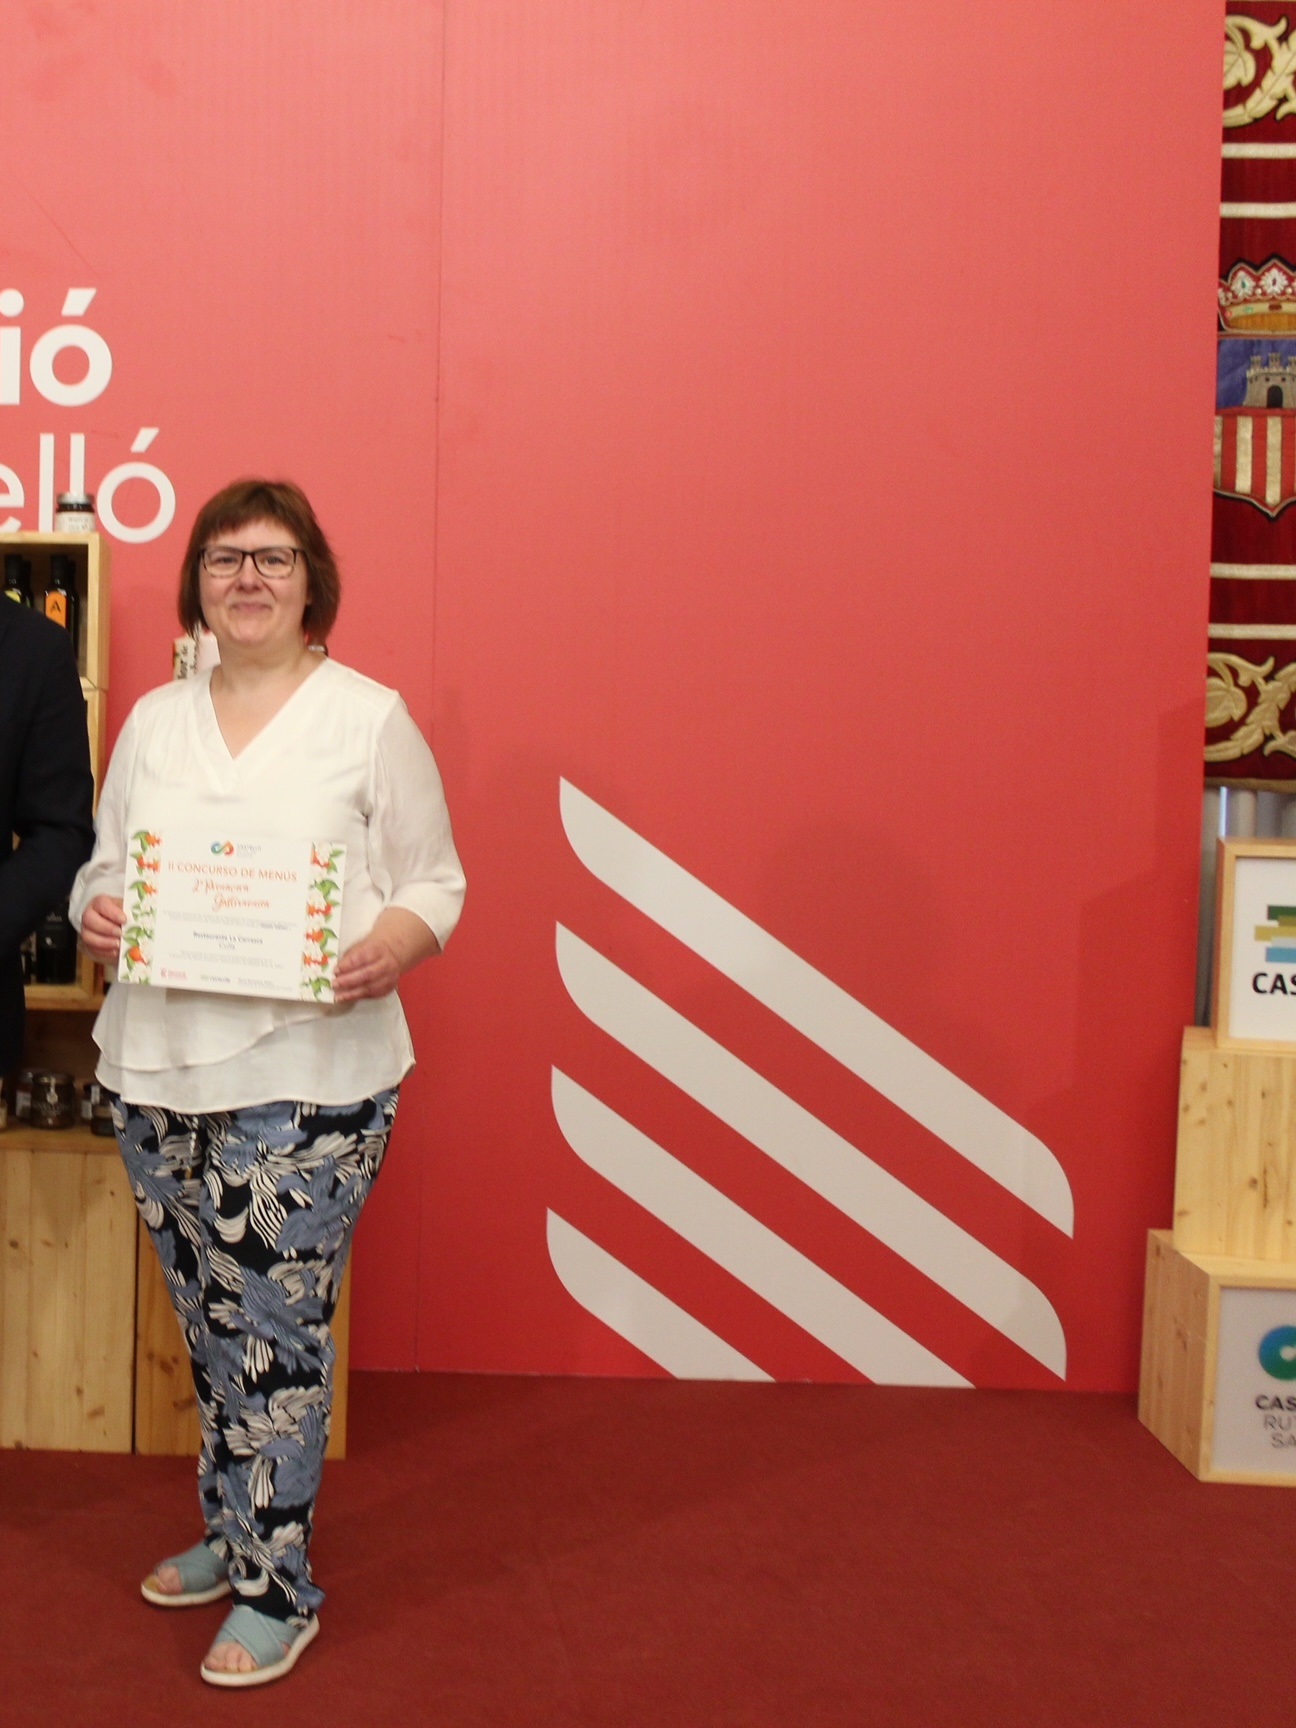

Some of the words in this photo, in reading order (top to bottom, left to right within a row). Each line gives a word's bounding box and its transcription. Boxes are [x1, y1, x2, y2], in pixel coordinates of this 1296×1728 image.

[177, 862, 238, 877] CONCURSO
[241, 867, 255, 878] DE
[1264, 1413, 1296, 1431] RU
